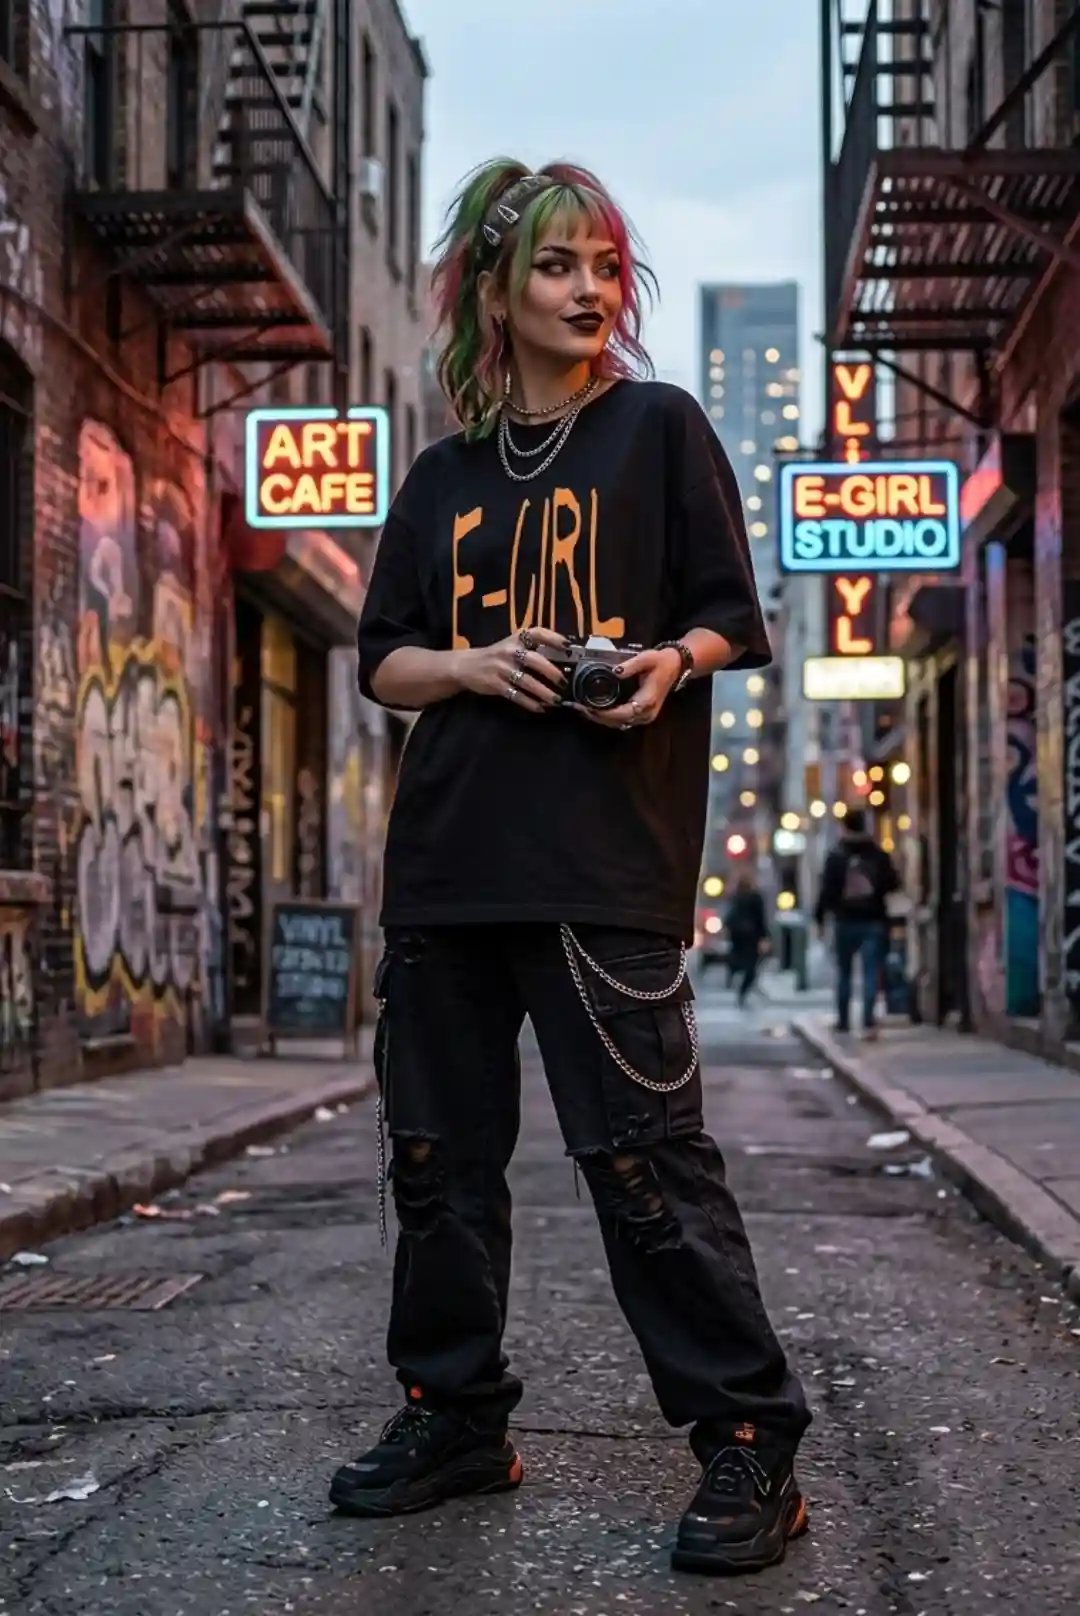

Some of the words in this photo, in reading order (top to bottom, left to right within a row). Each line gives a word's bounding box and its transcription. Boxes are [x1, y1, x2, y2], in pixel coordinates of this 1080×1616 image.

[262, 422, 372, 469] ART
[260, 472, 374, 514] CAFE
[795, 475, 946, 517] E-GIRL
[794, 519, 947, 559] STUDIO
